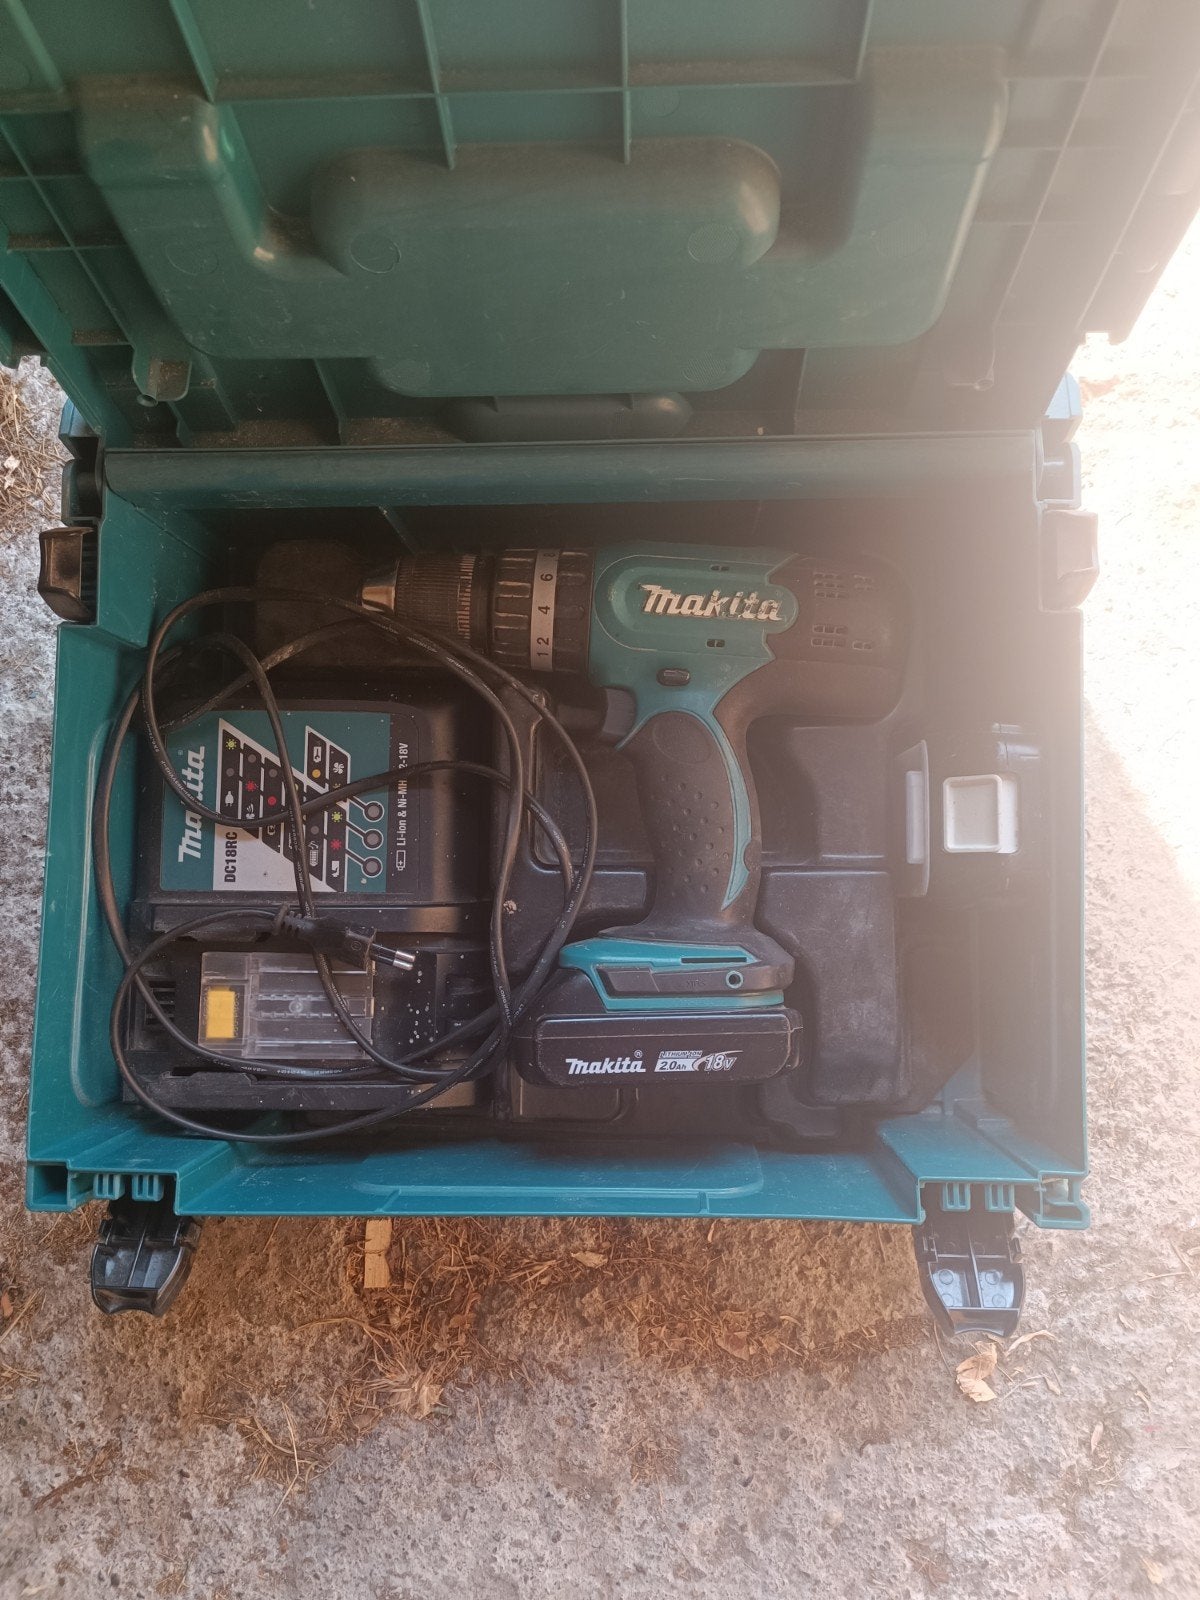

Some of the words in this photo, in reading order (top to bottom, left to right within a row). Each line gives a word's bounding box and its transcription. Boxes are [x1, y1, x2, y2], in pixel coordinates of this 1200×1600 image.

[540, 573, 553, 582] 6
[537, 605, 550, 615] 4
[640, 584, 784, 621] Makita
[536, 637, 549, 646] 2
[398, 742, 409, 769] 2-18V
[178, 746, 205, 863] Maita
[397, 780, 407, 808] Ni-MH
[397, 810, 407, 818] &
[396, 820, 407, 846] Li-Ion
[224, 831, 238, 883] DC18RC
[565, 1057, 646, 1075] Makita
[659, 1060, 687, 1071] 2.0Ah
